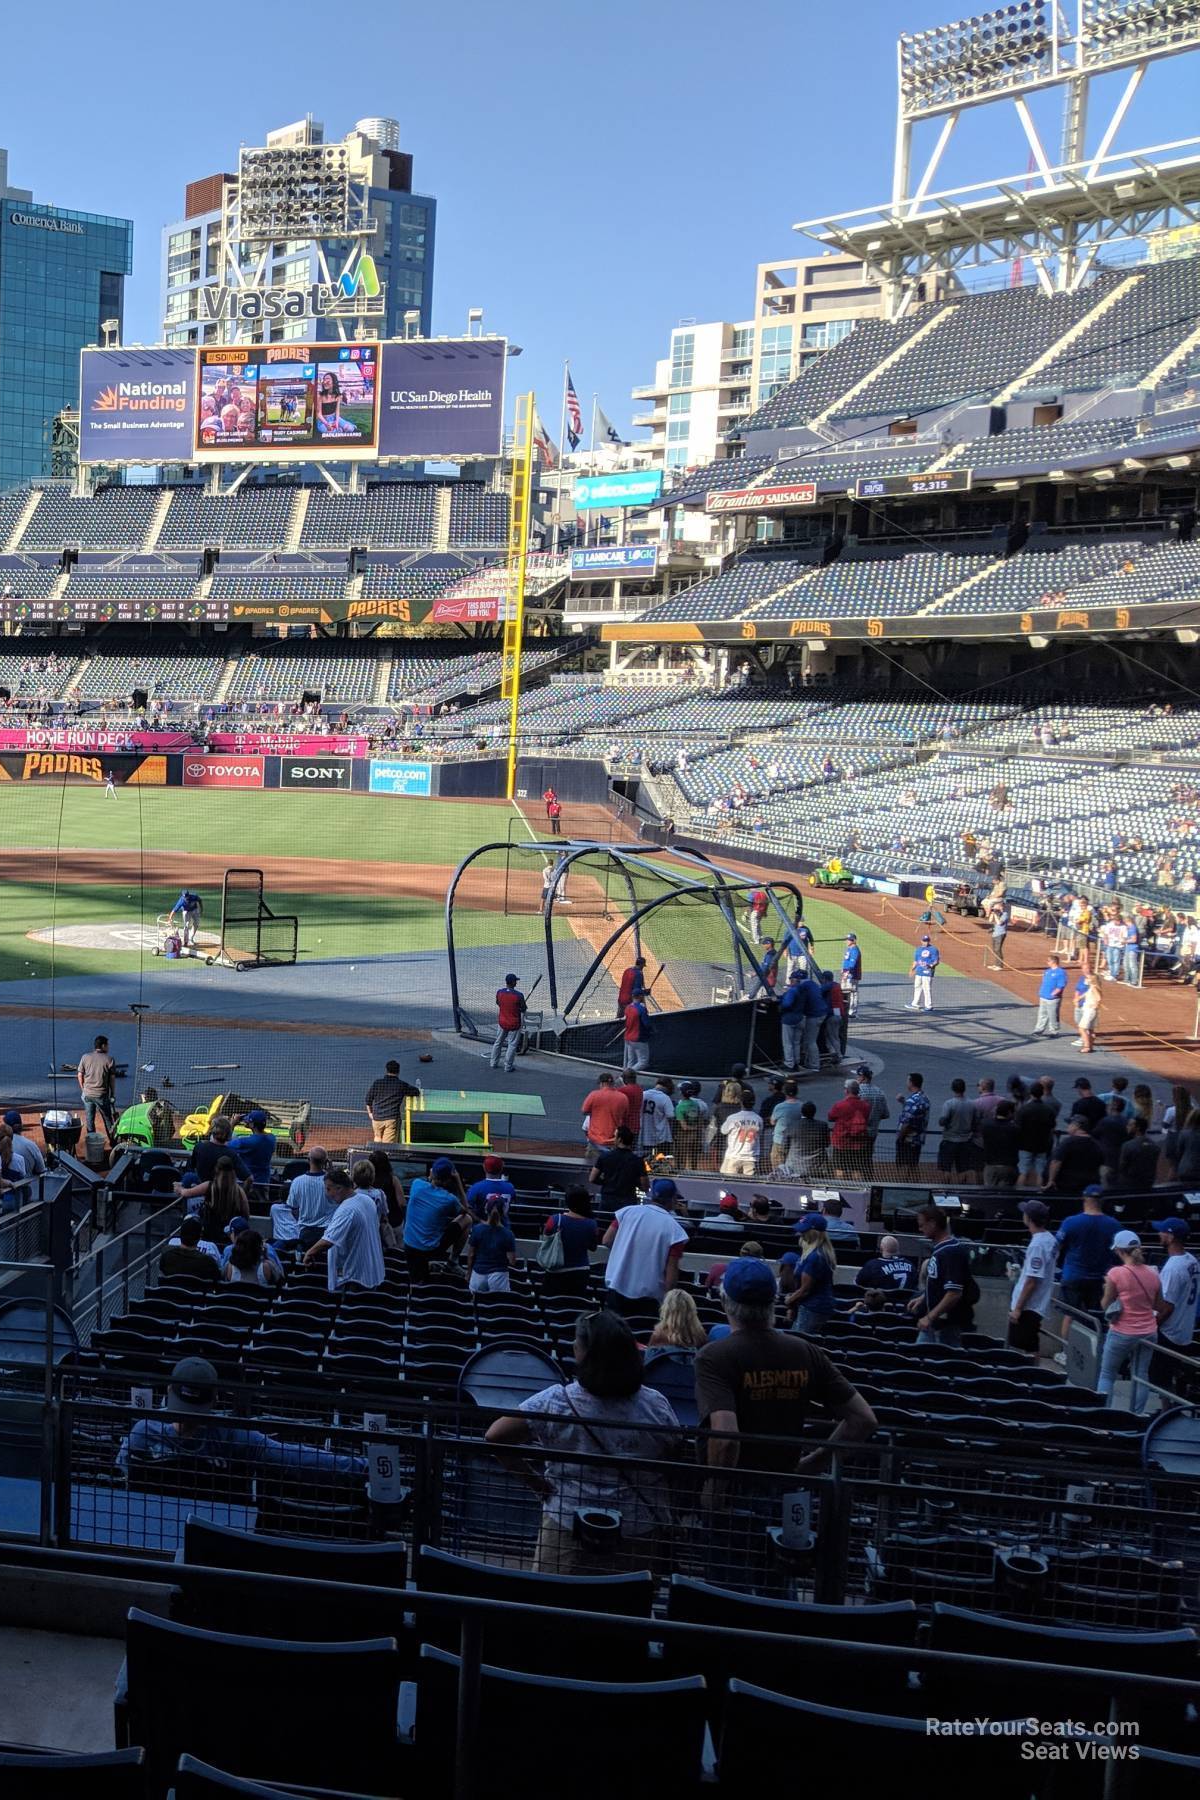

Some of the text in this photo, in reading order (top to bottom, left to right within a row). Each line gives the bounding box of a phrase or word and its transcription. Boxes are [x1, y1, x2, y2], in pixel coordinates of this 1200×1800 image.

[60, 220, 85, 233] Bank
[202, 283, 326, 319] Viasat
[208, 351, 246, 363] #SDINHD
[266, 347, 310, 364] PADRES
[119, 380, 187, 396] National
[391, 389, 492, 404] UC San Diego Health
[119, 396, 186, 412] Funding
[122, 421, 149, 429] Business
[150, 421, 185, 430] Advantage
[912, 480, 948, 492] $2,315
[709, 489, 813, 509] Tarantino SAUSAGES
[585, 549, 655, 562] LANDCARE LOGIC
[107, 607, 113, 615] 2
[150, 607, 156, 615] 3
[195, 607, 200, 615] 2
[245, 607, 275, 615] @PADRES
[290, 607, 319, 615] @PADRES
[347, 600, 410, 622] PADRES
[480, 601, 496, 609] BUD'S
[1056, 611, 1089, 630] PADRES
[789, 619, 832, 637] PADRES
[26, 731, 133, 746] HOME RUN DECK
[22, 752, 103, 782] PADRES
[207, 765, 260, 777] TOYOTA
[291, 767, 345, 779] SONY
[374, 766, 426, 780] petco.com
[892, 1272, 908, 1289] 7
[744, 1370, 809, 1388] ALESMITH
